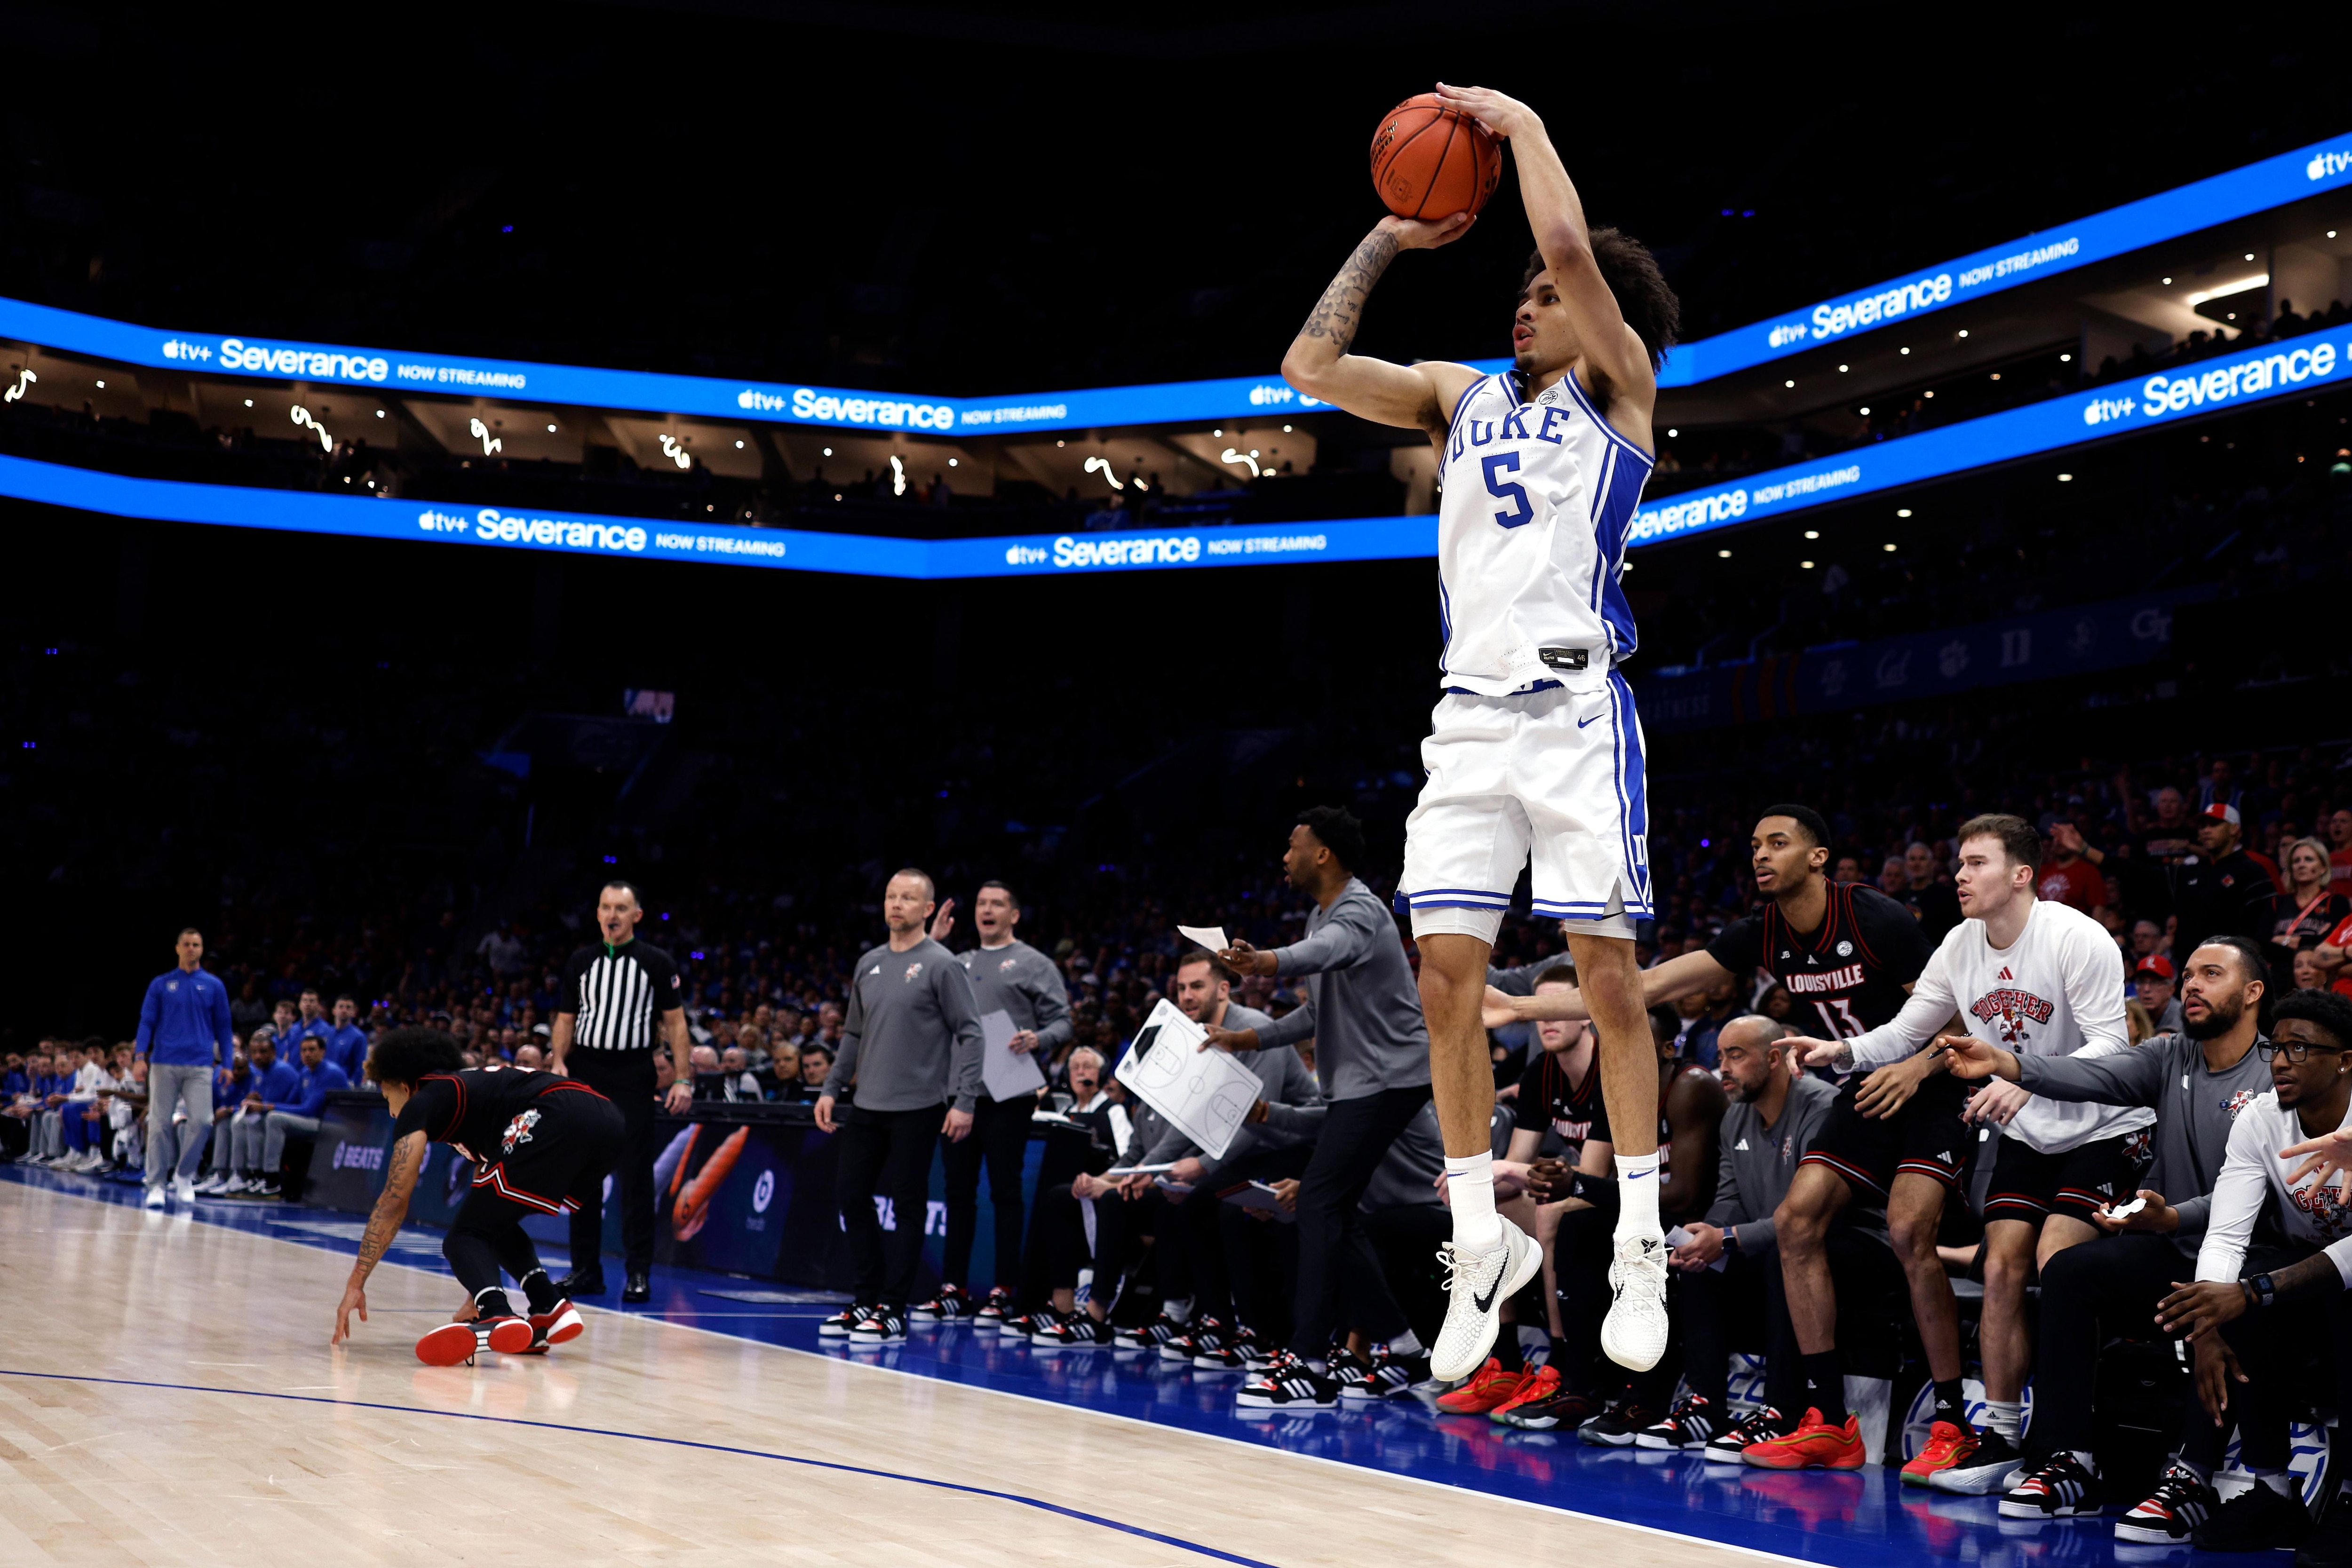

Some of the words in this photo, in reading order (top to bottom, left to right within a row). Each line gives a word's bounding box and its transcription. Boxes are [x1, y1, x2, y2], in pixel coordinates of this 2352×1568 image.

[1781, 324, 1808, 344] tv+
[1812, 274, 1952, 339] Severance
[1959, 264, 1995, 288] NOW
[1995, 238, 2079, 277] STREAMING
[180, 341, 212, 361] tv+
[220, 339, 389, 381] Severance
[397, 364, 437, 380] NOW
[437, 367, 526, 388] STREAMING
[2101, 398, 2136, 421] tv+
[2143, 343, 2336, 416] Severance
[754, 391, 786, 411] tv+
[792, 388, 954, 429] Severance
[961, 410, 993, 424] NOW
[993, 404, 1067, 423] STREAMING
[1264, 386, 1294, 405] tv+
[1452, 406, 1570, 463] DUKE
[1481, 451, 1534, 529] 5
[1753, 484, 1785, 505] NOW
[1785, 466, 1860, 498] STREAMING
[435, 513, 469, 532] tv+
[476, 509, 647, 551] Severance
[656, 533, 695, 550] NOW
[696, 536, 785, 557] STREAMING
[1019, 546, 1049, 564] tv+
[1053, 537, 1200, 567] Severance
[1208, 539, 1242, 554] NOW
[1242, 535, 1327, 554] STREAMING
[1781, 950, 1790, 959] JB
[1786, 963, 1866, 994] LOUISVILLE
[1811, 997, 1867, 1041] 13
[1970, 988, 2055, 1025] TOGETHER
[343, 1144, 384, 1171] BEATS
